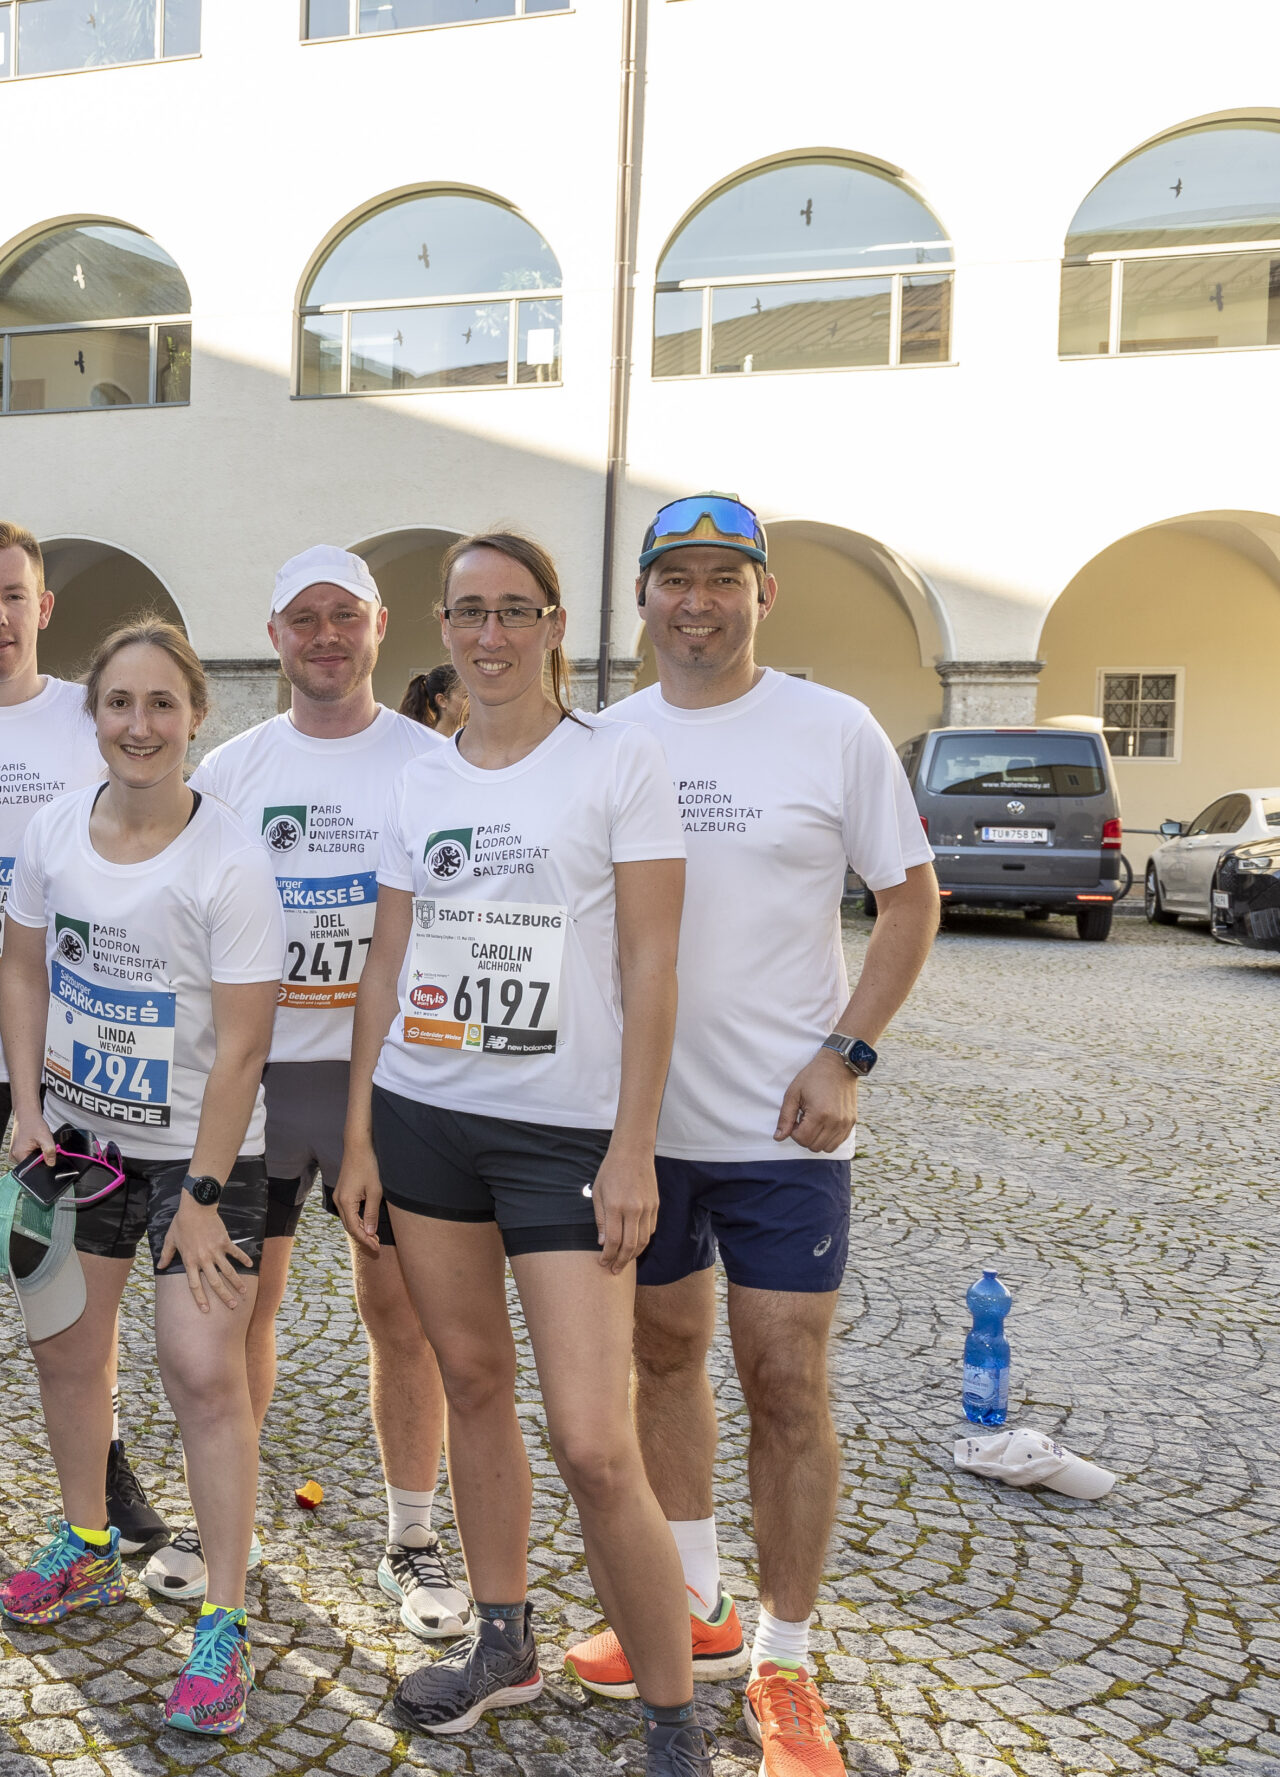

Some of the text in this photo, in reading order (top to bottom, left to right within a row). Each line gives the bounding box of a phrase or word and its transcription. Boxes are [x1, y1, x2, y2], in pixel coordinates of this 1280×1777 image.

[679, 780, 717, 790] PARIS
[678, 794, 732, 804] LODRON
[311, 806, 342, 814] PARIS
[310, 818, 354, 827] LODRON
[477, 824, 510, 835] PARIS
[682, 822, 746, 832] ALZBURG
[310, 830, 379, 840] UNIVERSITÄT
[308, 844, 365, 853] SALZBURG
[476, 836, 522, 849] LODRON
[474, 846, 550, 862] UNIVERSITÄT
[473, 864, 534, 876] SALZBURG
[314, 914, 344, 928] JOEL
[438, 909, 562, 928] STADT SALZBURG
[93, 924, 127, 938] PARIS
[310, 928, 350, 939] HERMANN
[92, 936, 140, 954] LODRON
[472, 942, 532, 962] CAROLIN
[93, 951, 168, 970] UNIVERSITÄT
[478, 960, 522, 972] AICHHORN
[93, 963, 152, 982] SALZBURG
[60, 969, 91, 996] Salzburger
[58, 980, 136, 1022] SPARKASSE
[288, 992, 332, 1000] Gebrüder
[413, 989, 444, 1006] Hervis
[454, 976, 550, 1028] 6197
[98, 1024, 136, 1045] LINDA
[100, 1041, 132, 1055] WEYAND
[524, 1043, 552, 1052] balance
[84, 1049, 152, 1101] 294
[46, 1073, 162, 1126] POWERADE
